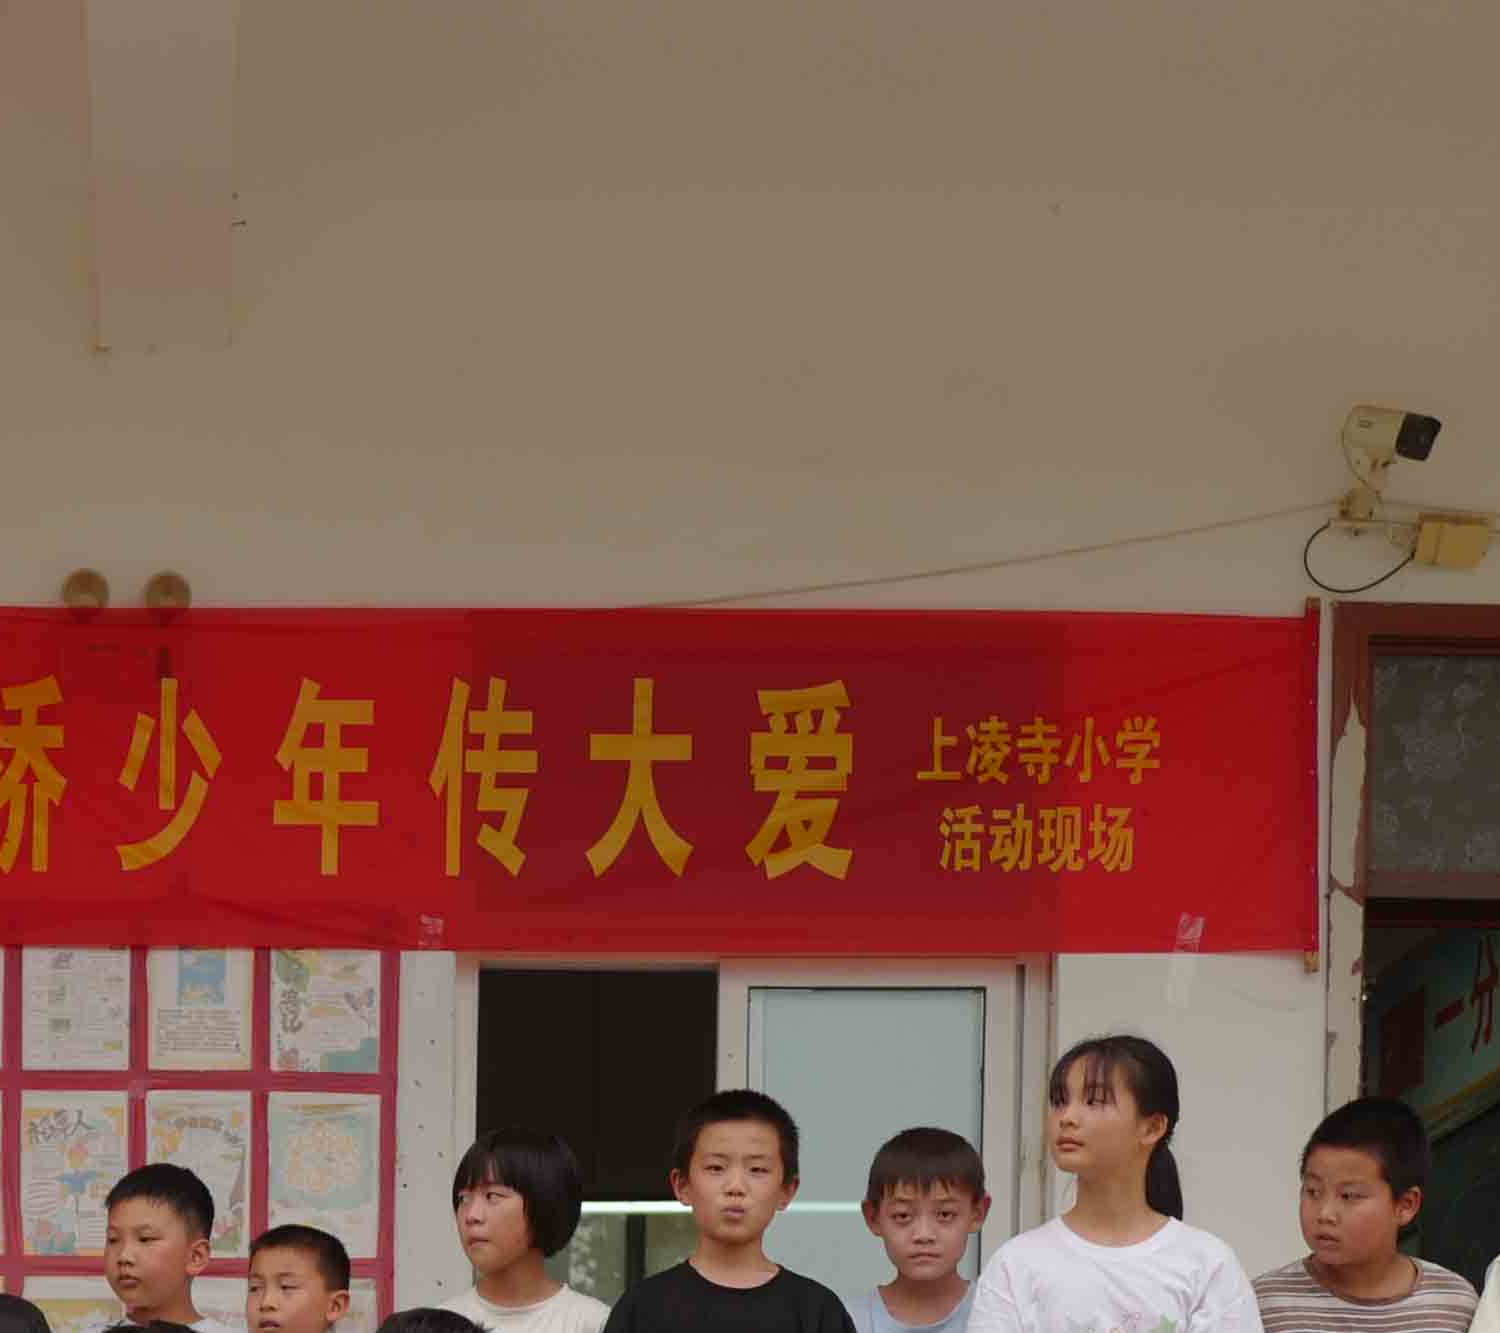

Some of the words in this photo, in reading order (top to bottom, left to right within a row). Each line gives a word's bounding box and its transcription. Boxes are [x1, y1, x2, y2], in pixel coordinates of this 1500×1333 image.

[917, 715, 1162, 786] 上凌寺小学
[938, 803, 1135, 873] 活动现场
